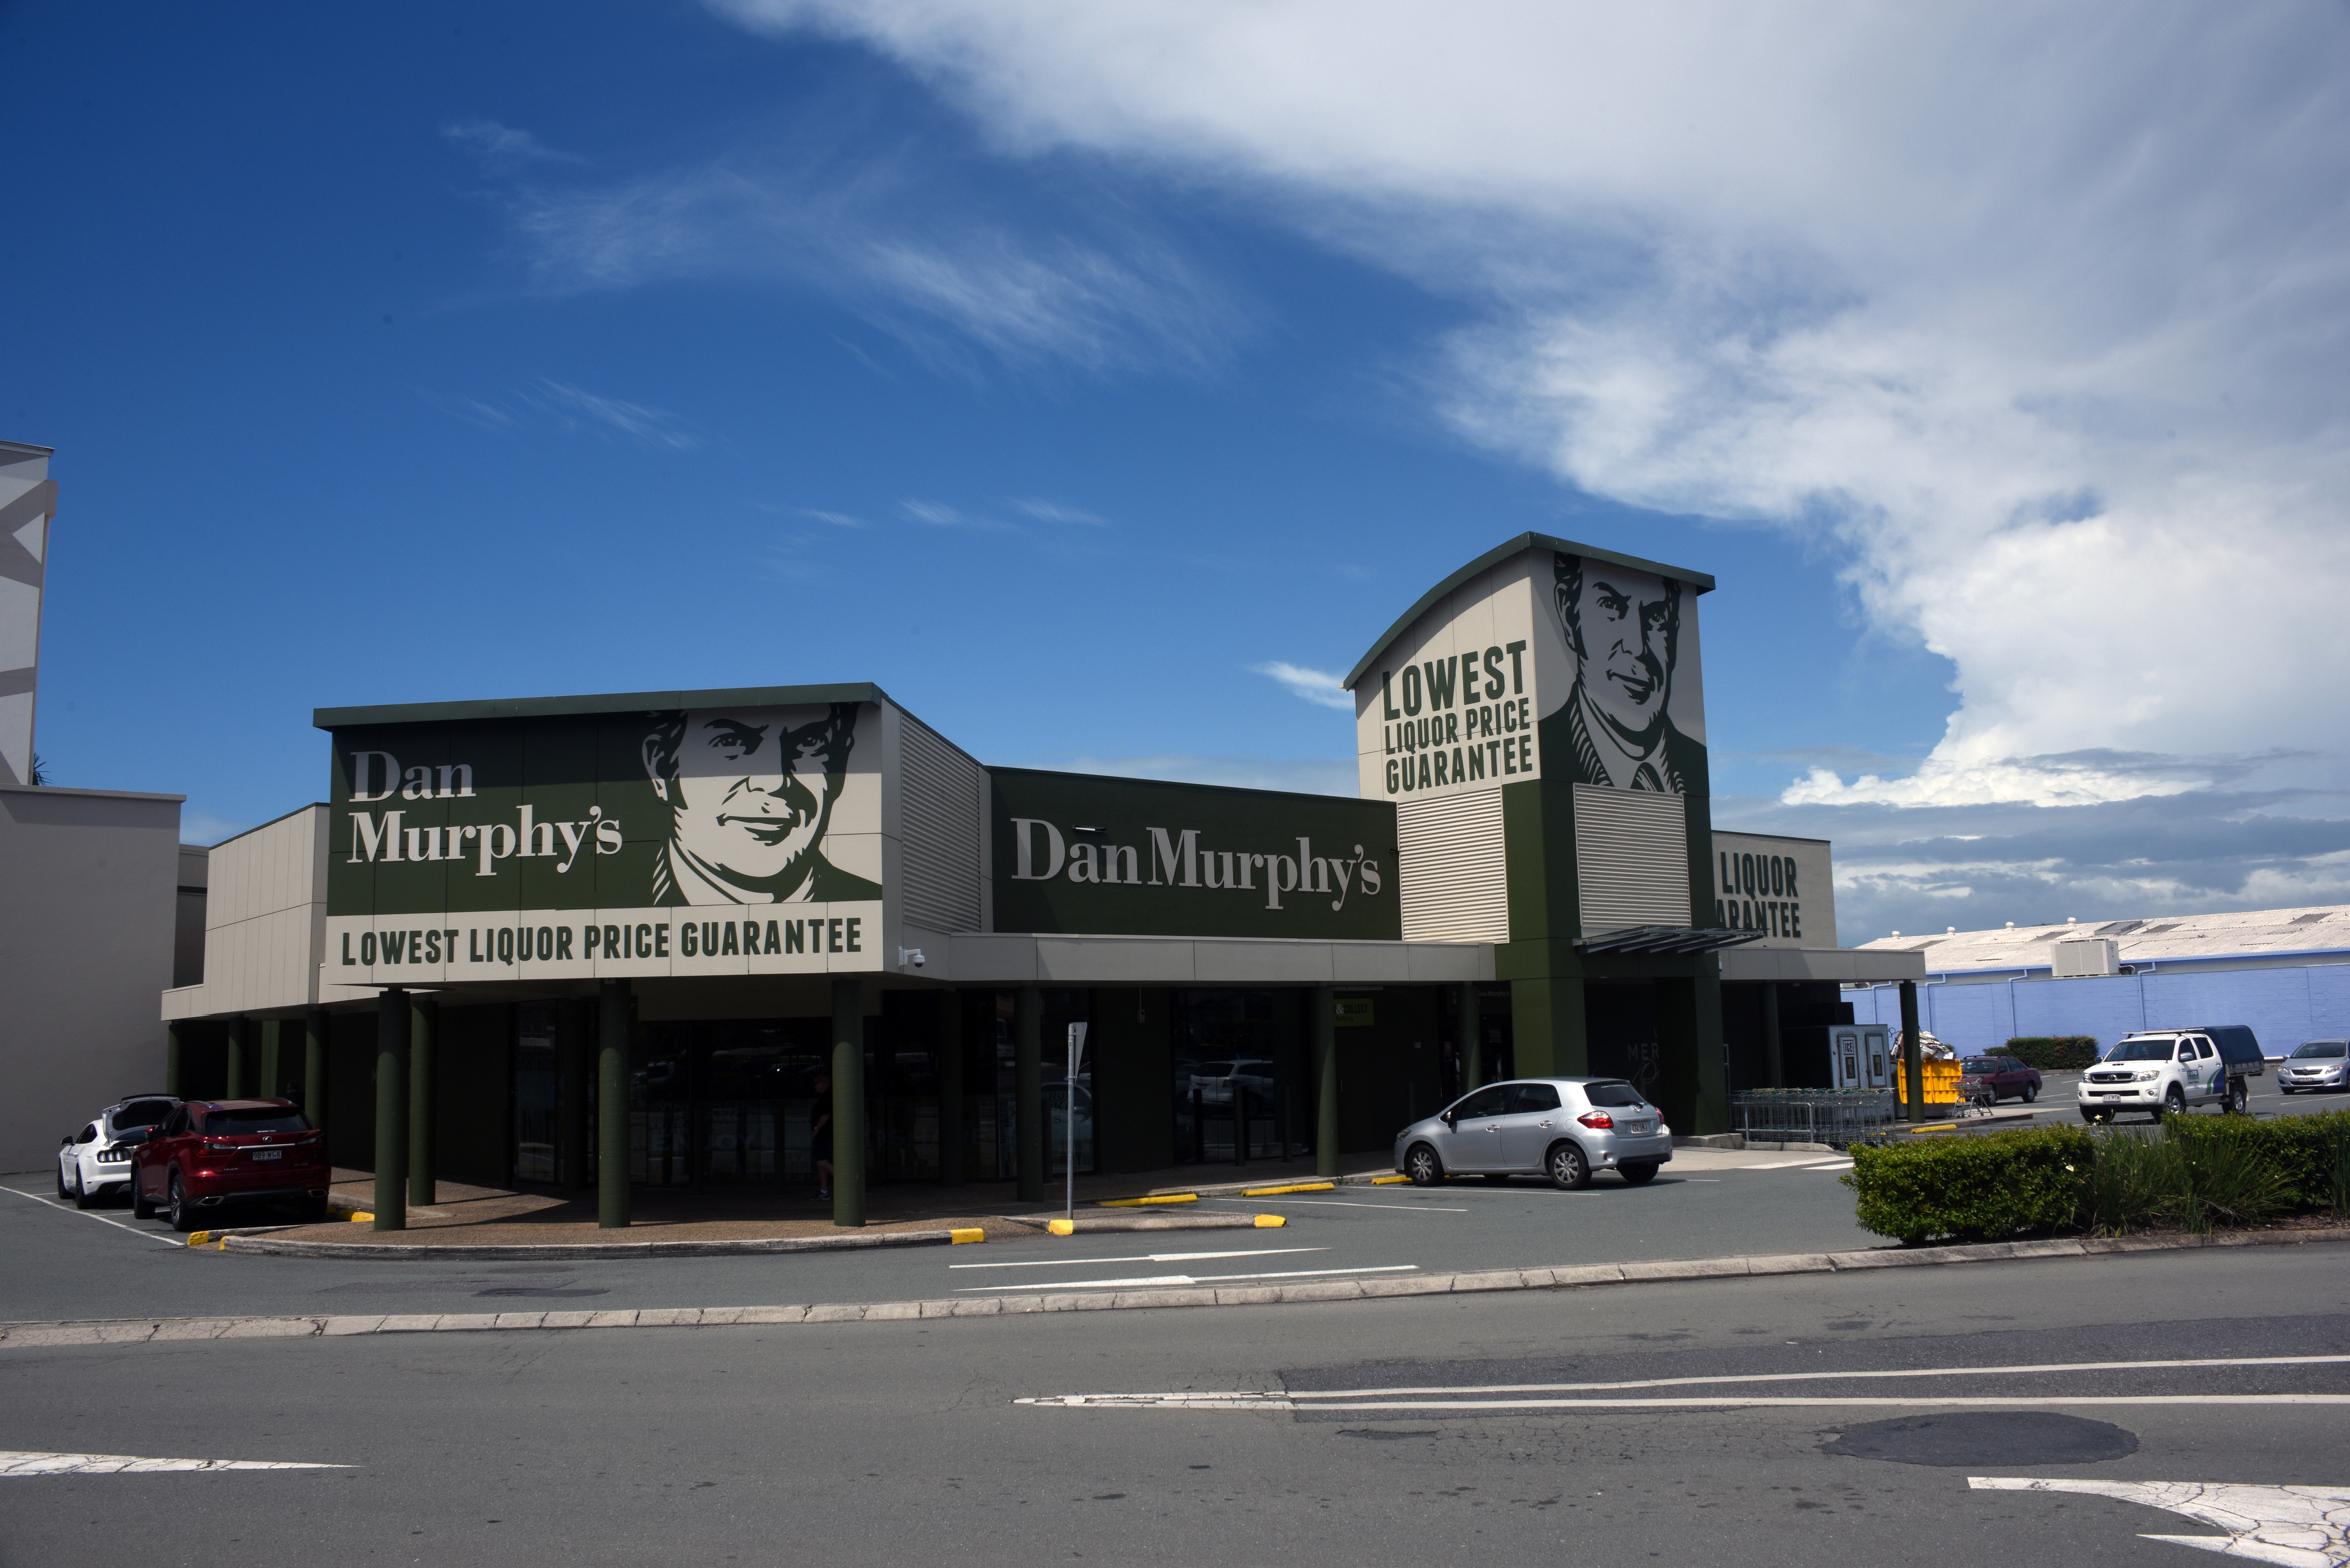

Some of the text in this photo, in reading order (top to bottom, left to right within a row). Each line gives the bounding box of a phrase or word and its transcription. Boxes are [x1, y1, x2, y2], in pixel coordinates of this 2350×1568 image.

[1383, 639, 1526, 720] LOWEST
[1385, 697, 1529, 756] LIQUOR PRICE
[349, 751, 476, 802] Dan
[1386, 734, 1533, 794] GUARANTEE
[347, 804, 622, 876] Murphy's
[1010, 817, 1380, 911] Dan Murphy's
[1720, 852, 1798, 900] LIQUOR
[342, 917, 861, 966] LOWEST LIQUOR PRICE GUARANTEE
[1716, 899, 1801, 937] ARANTEE
[888, 1129, 990, 1148] SHE
